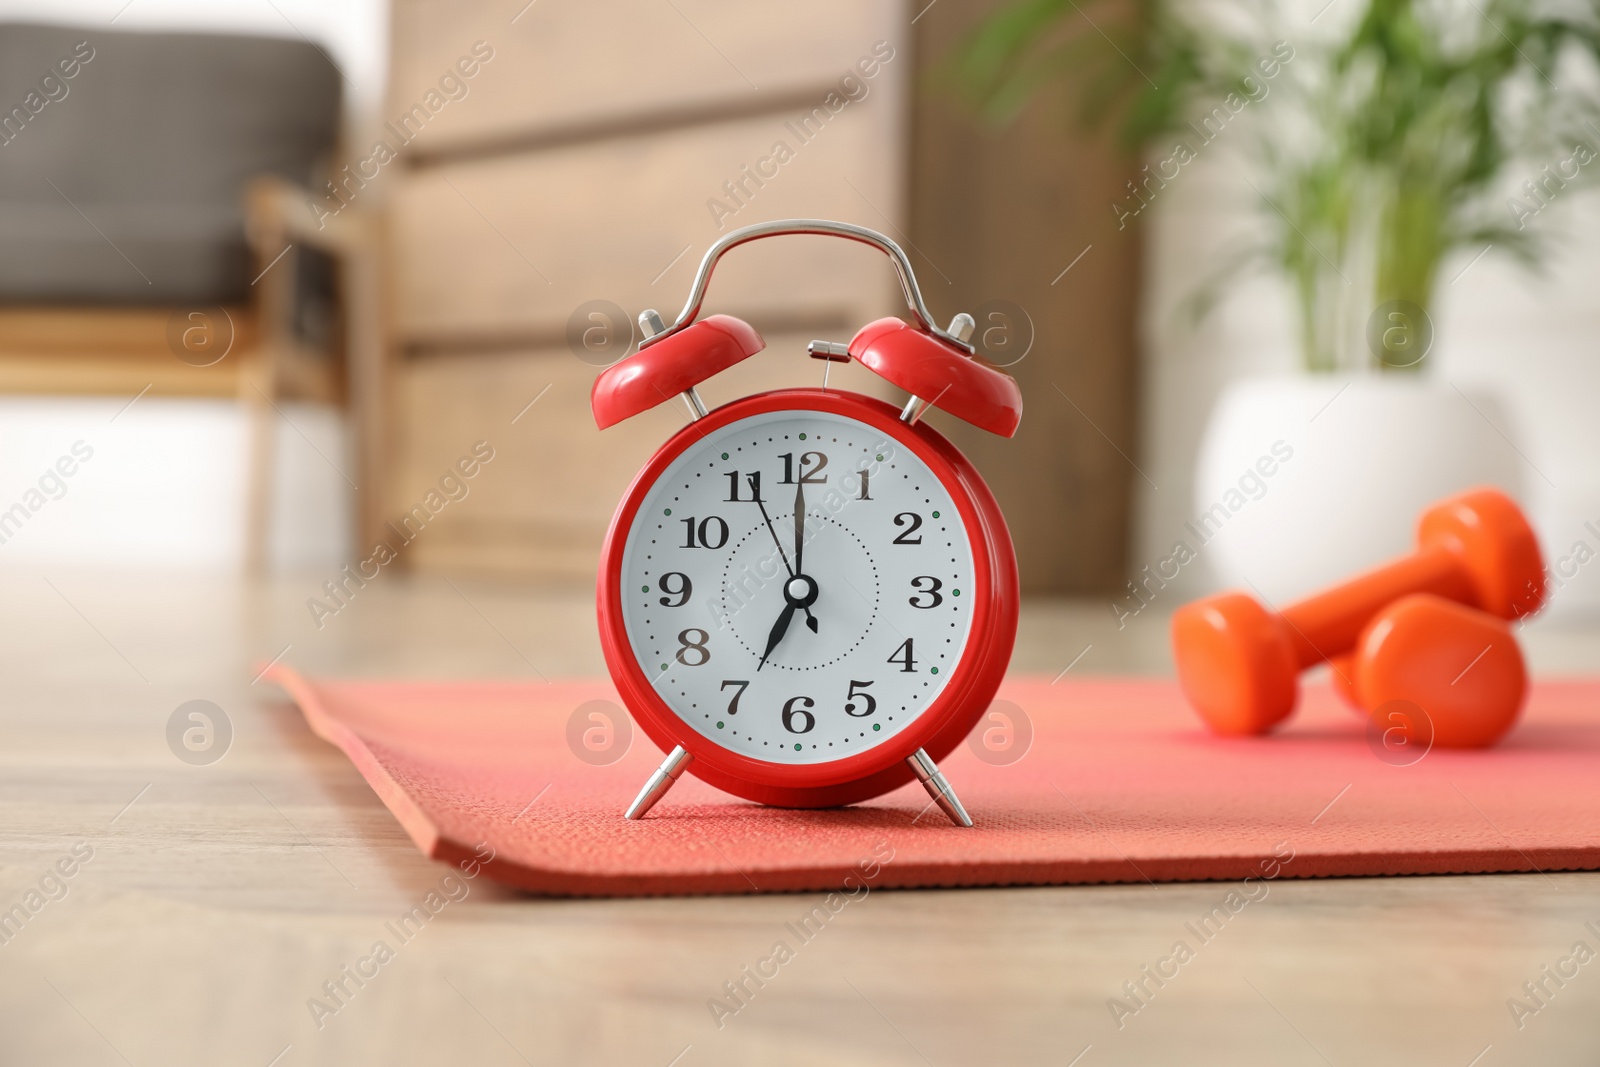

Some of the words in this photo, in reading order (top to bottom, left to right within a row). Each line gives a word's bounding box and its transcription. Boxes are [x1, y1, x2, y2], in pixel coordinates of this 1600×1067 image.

[777, 451, 828, 485] 12
[856, 468, 874, 501] 1
[722, 470, 767, 502] 11
[678, 516, 730, 550] 10
[892, 511, 923, 545] 2
[658, 571, 693, 608] 9
[908, 575, 943, 609] 3
[675, 628, 711, 667] 8
[886, 638, 918, 673] 4
[720, 680, 750, 716] 7
[781, 696, 816, 734] 6
[844, 679, 877, 718] 5
